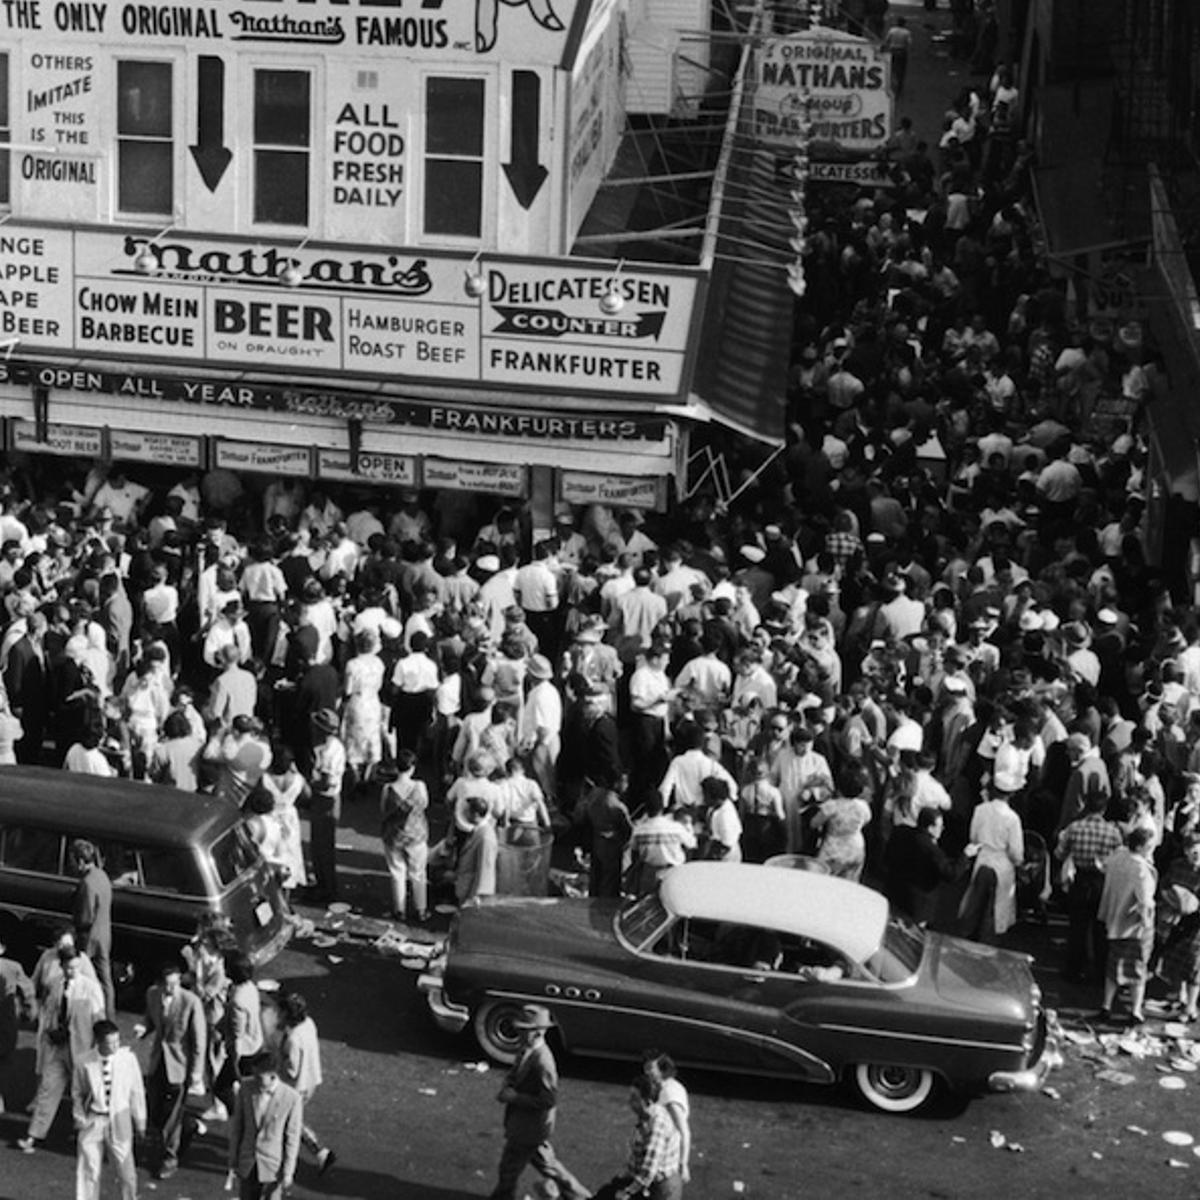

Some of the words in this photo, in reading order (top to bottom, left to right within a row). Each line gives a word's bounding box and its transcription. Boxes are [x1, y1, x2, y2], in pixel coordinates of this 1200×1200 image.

[1, 0, 42, 31] THE
[53, 1, 108, 33] ONLY
[121, 3, 224, 39] ORIGINAL
[227, 10, 346, 36] Nathan's
[355, 15, 450, 49] FAMOUS
[31, 53, 94, 71] OTHERS
[762, 62, 882, 90] NATHANS
[27, 75, 93, 113] IMITATE
[53, 111, 85, 125] THIS
[335, 102, 400, 128] ALL
[30, 128, 46, 143] IS
[55, 129, 90, 145] THE
[333, 131, 405, 158] FOOD
[21, 154, 97, 184] ORIGINAL
[332, 161, 404, 184] FRESH
[332, 186, 403, 208] DAILY
[78, 286, 138, 314] CHOW
[142, 290, 199, 319] MEIN
[488, 269, 671, 309] DELICATESSEN
[2, 310, 60, 337] BEER
[80, 315, 195, 348] BARBECUE
[214, 300, 336, 342] BEER
[348, 308, 466, 338] HAMBURGER
[512, 313, 640, 338] COUNTER
[217, 341, 239, 352] ON
[246, 344, 324, 359] DRAUGHT
[348, 337, 406, 360] ROAST
[416, 342, 466, 365] BEEF
[490, 348, 662, 382] FRANKFURTER
[39, 368, 102, 389] OPEN
[119, 377, 164, 396] ALL
[183, 382, 255, 404] YEAR
[430, 407, 637, 437] FRANKFURTERS
[359, 456, 405, 473] OPEN
